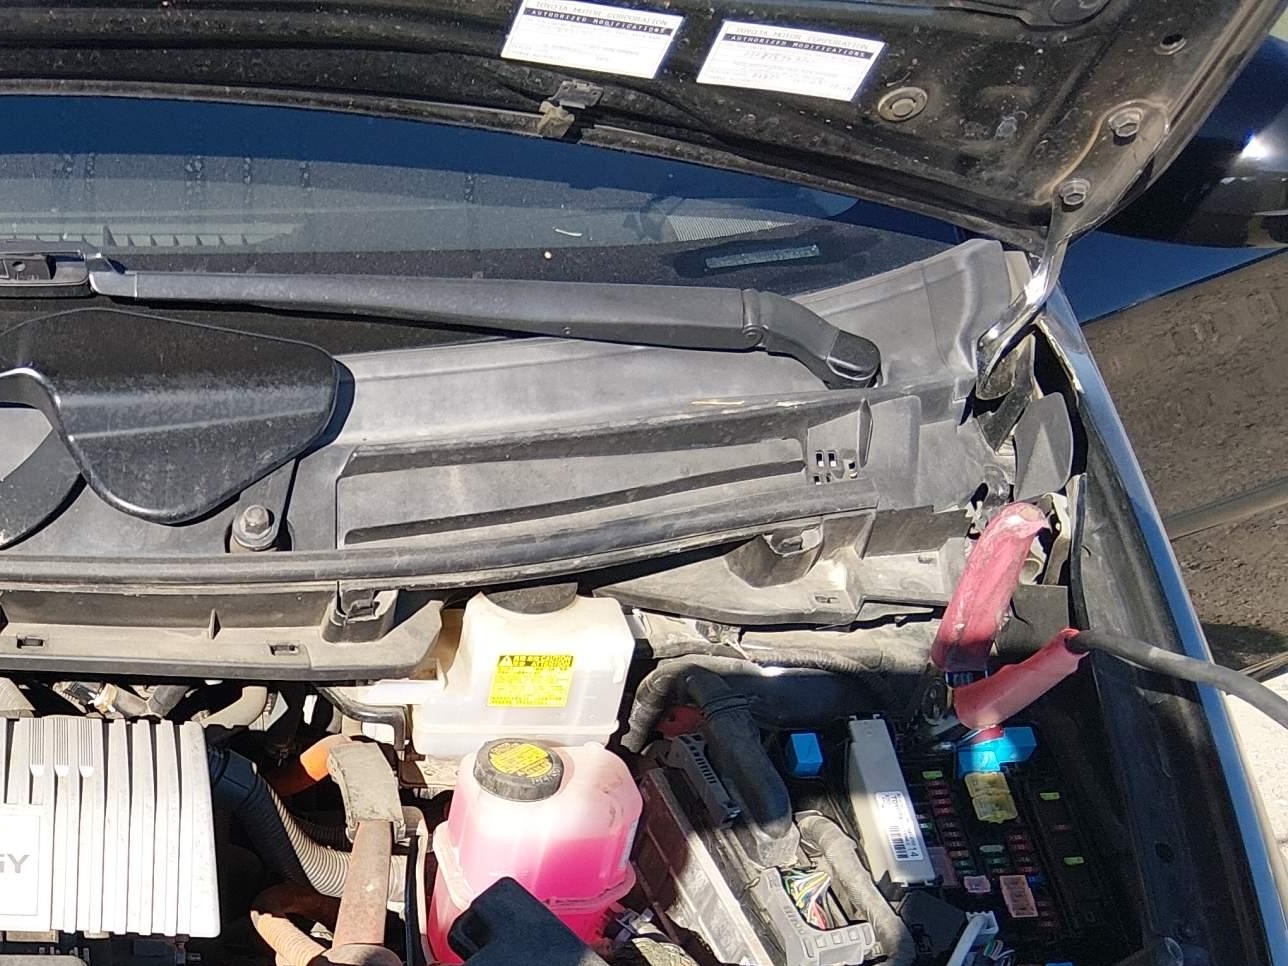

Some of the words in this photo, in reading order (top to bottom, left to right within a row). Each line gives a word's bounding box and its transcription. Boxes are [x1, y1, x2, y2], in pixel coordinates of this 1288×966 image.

[531, 10, 587, 23] AUTHORIZED
[593, 18, 666, 33] MODIFICATIONS
[730, 36, 787, 48] AUTHORIZED
[792, 42, 866, 58] MODIFICATIONS
